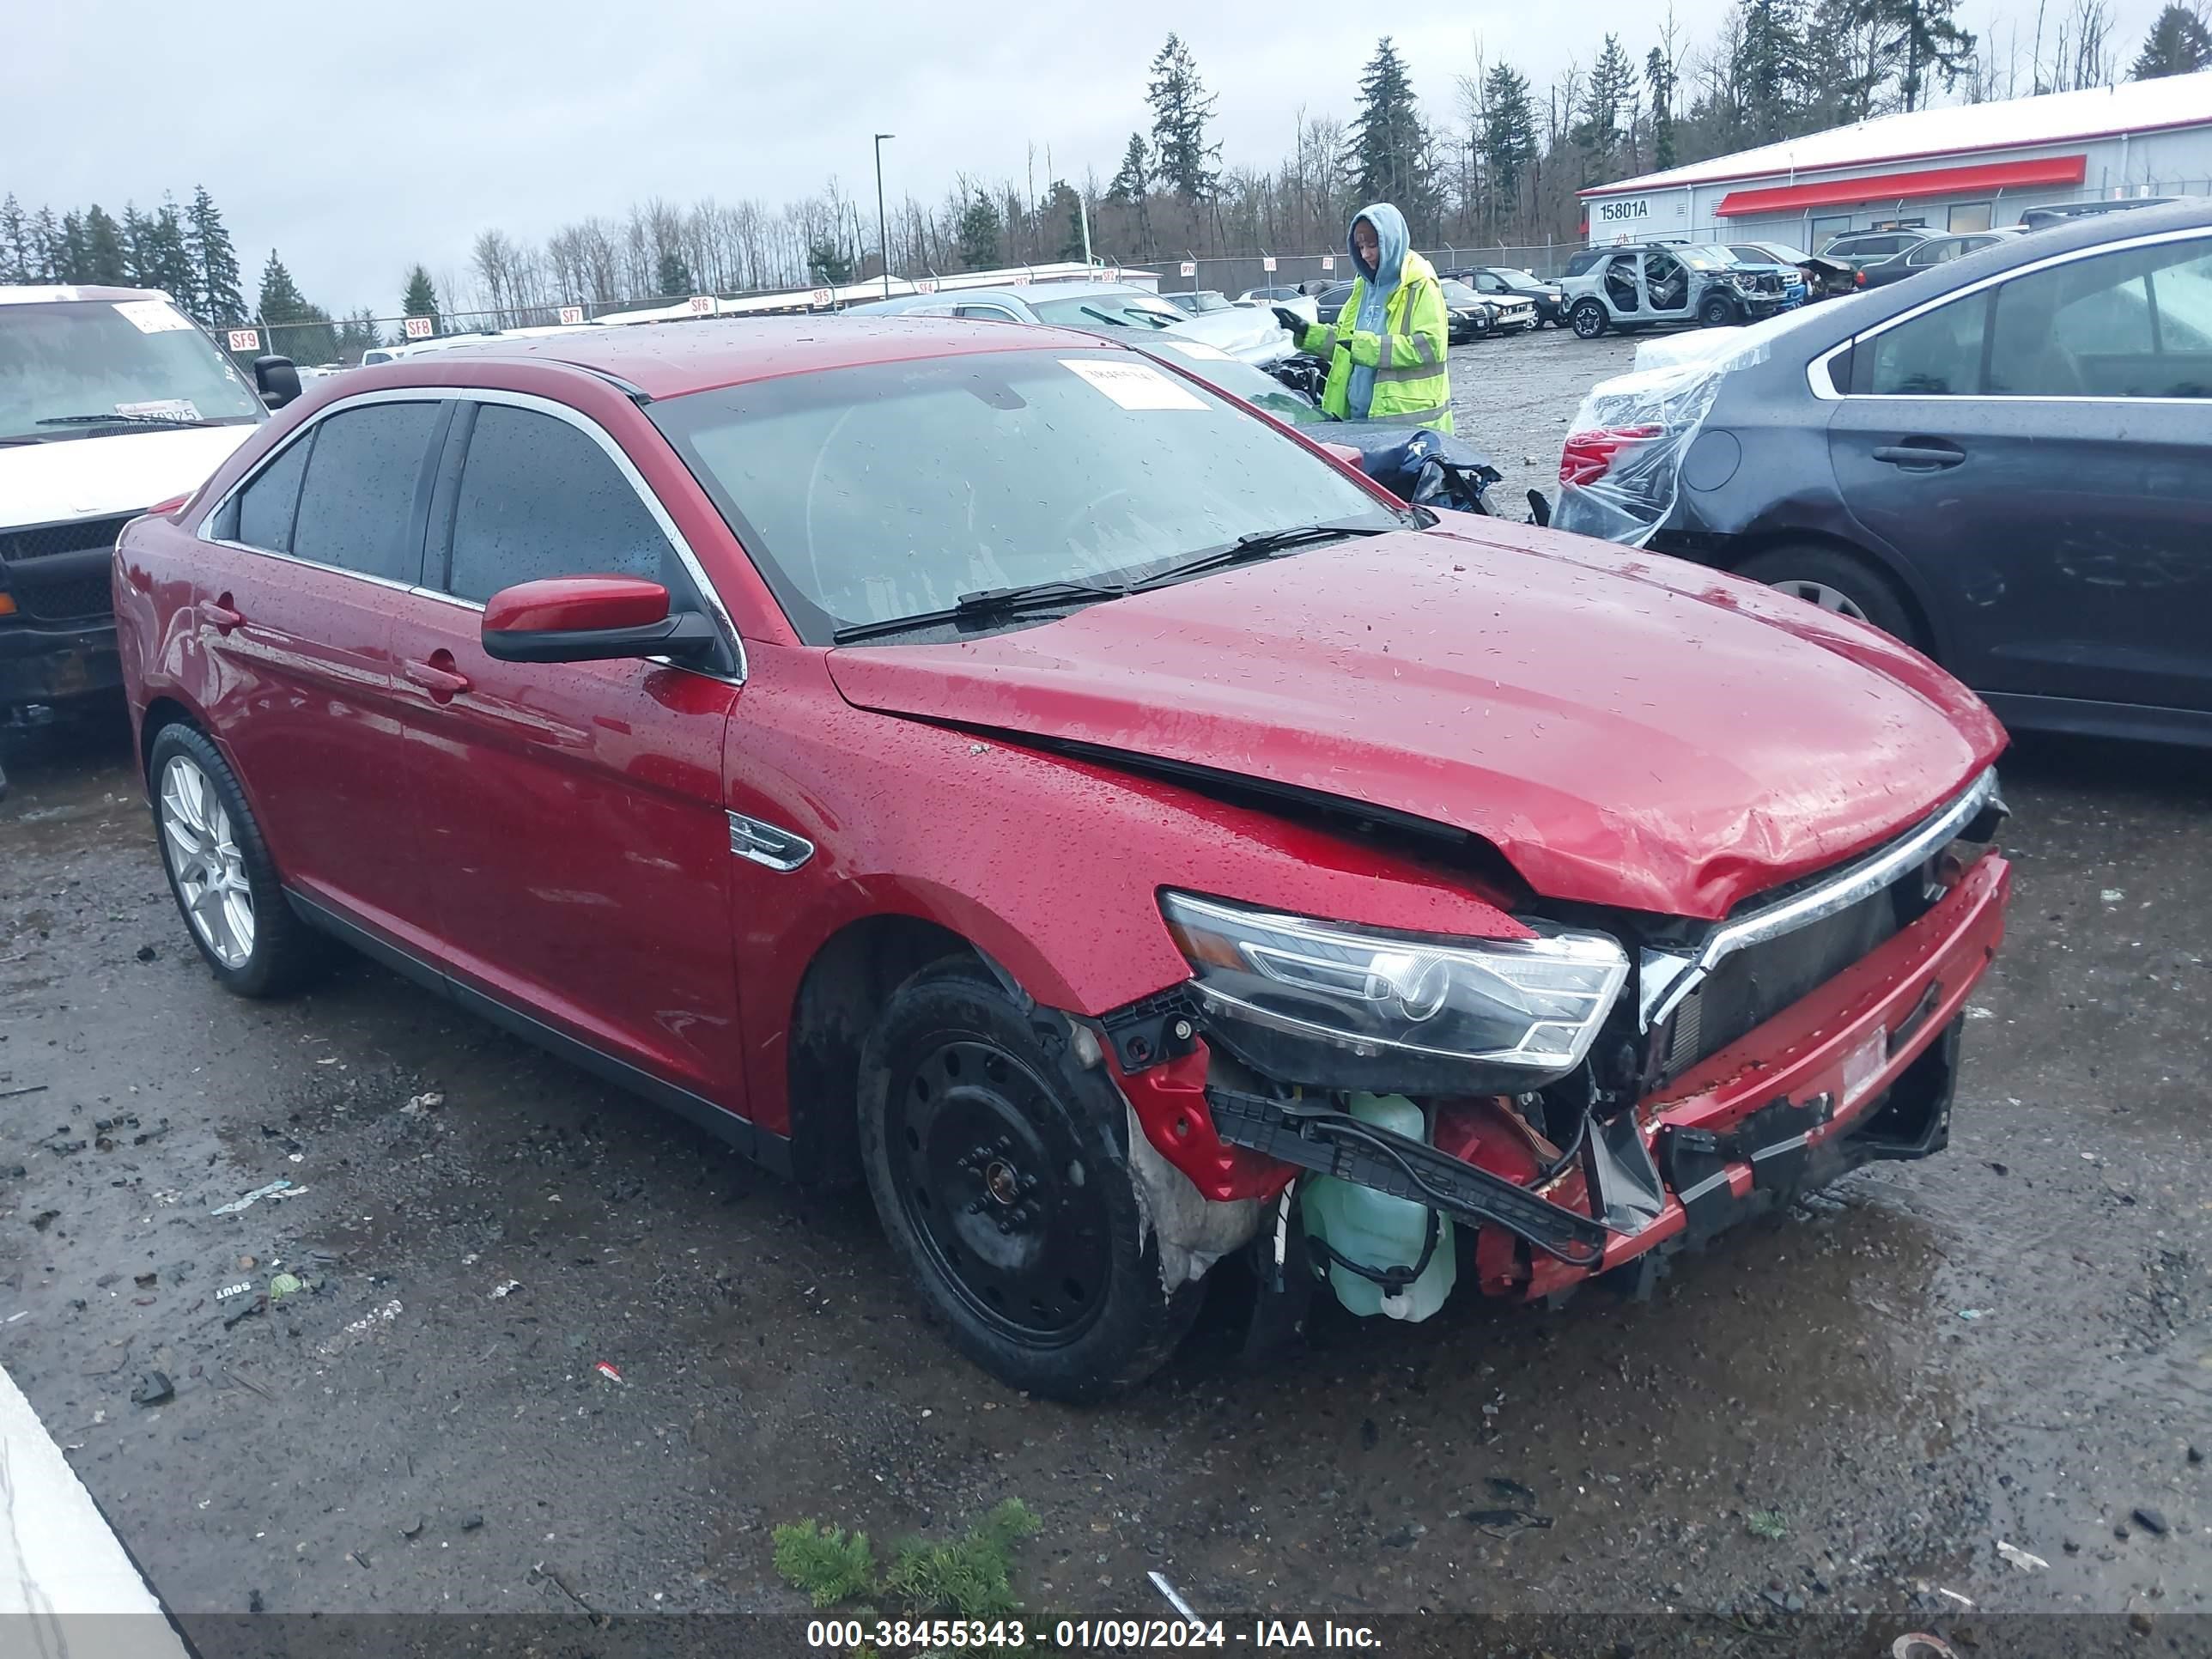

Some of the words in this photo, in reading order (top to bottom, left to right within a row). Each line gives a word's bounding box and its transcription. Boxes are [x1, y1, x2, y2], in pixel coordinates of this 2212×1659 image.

[1601, 200, 1648, 220] 15801A
[814, 290, 829, 303] SF5
[691, 298, 708, 312] SF6
[563, 309, 580, 323] SF7
[408, 320, 430, 336] SF8
[232, 332, 257, 349] SF9
[216, 1281, 252, 1300] SOUT
